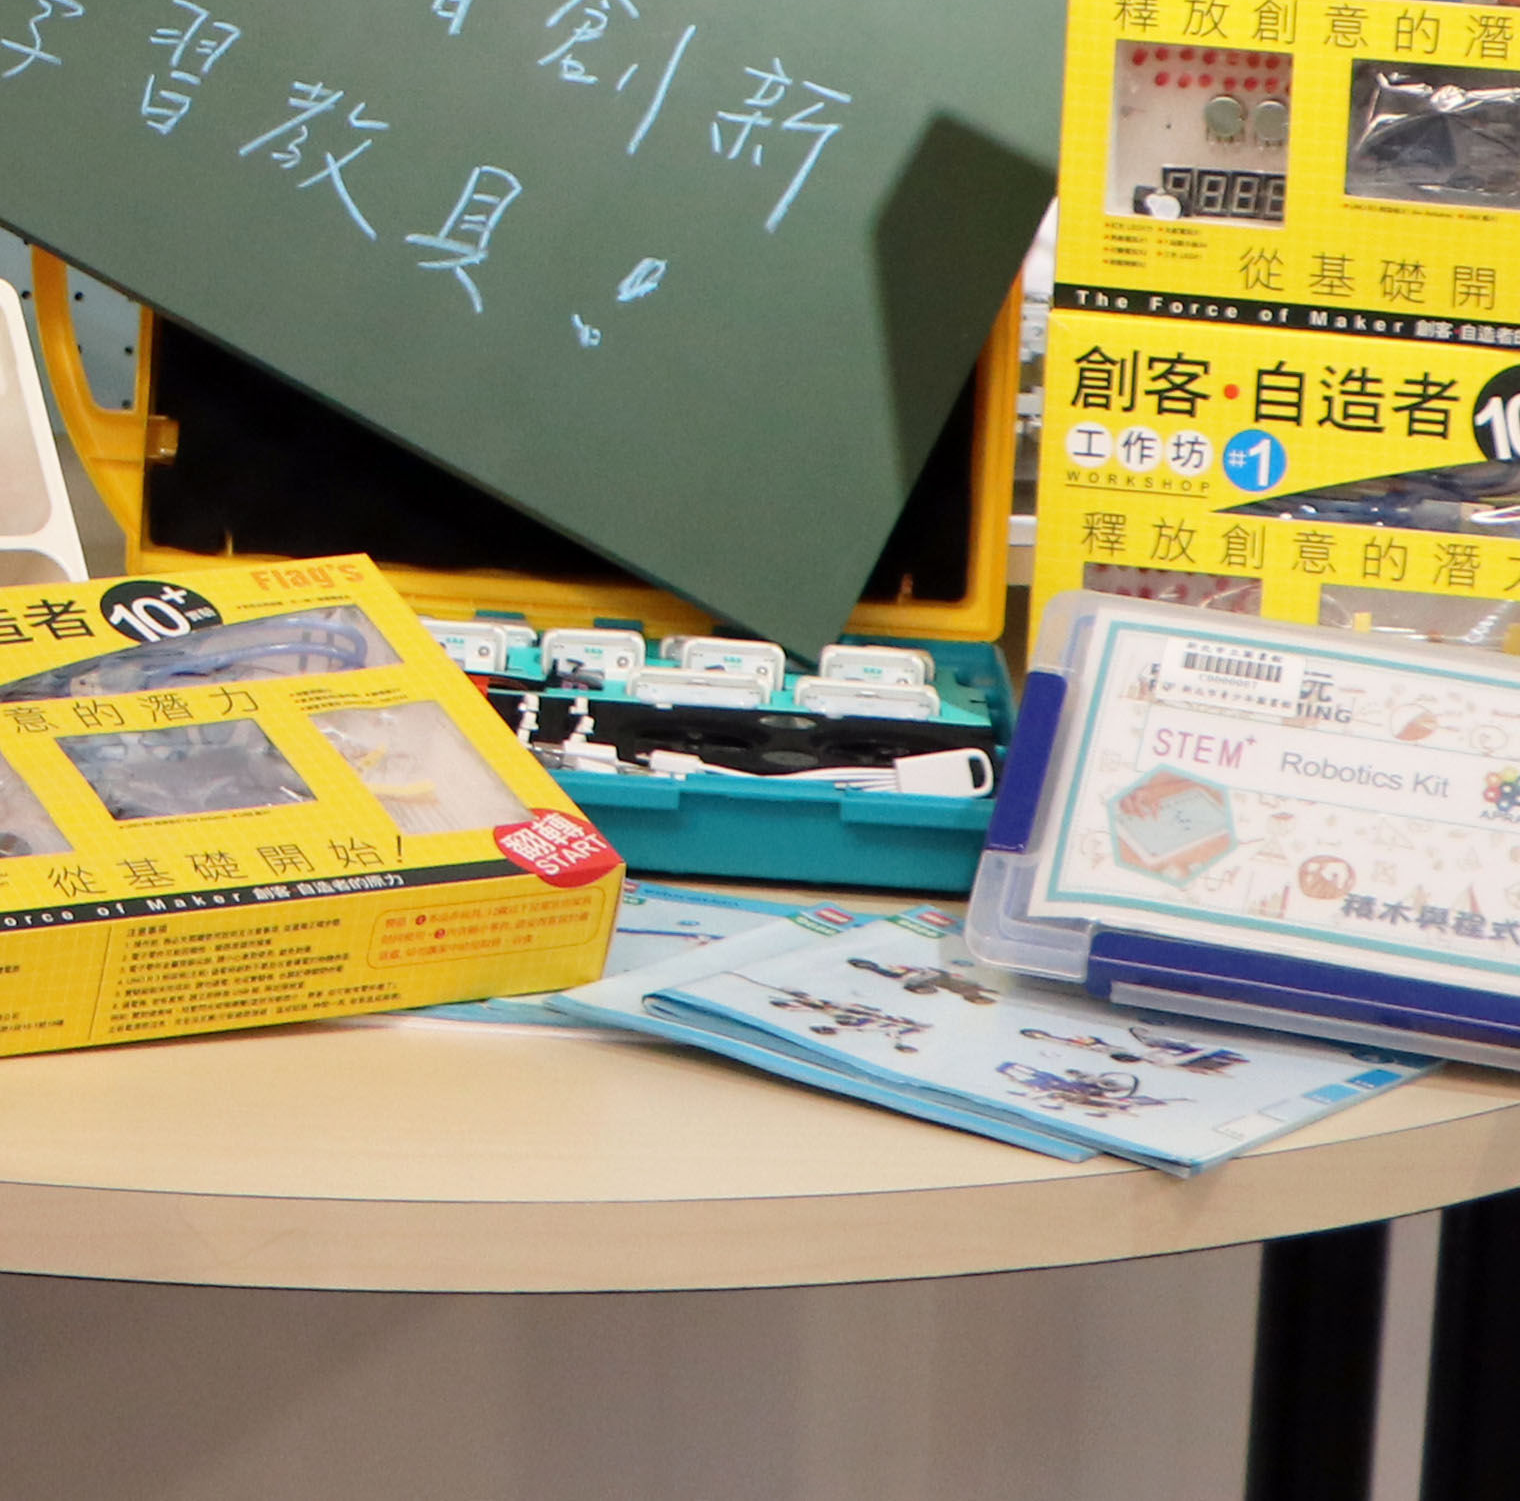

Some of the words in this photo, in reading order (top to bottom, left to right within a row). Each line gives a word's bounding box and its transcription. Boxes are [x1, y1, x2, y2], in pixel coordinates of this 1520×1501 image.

[1238, 246, 1498, 313] 從基礎開
[1076, 289, 1129, 310] The
[1149, 297, 1240, 320] Force
[1260, 307, 1290, 324] of
[1308, 309, 1405, 334] Maker
[1075, 424, 1210, 470] 工作坊
[1227, 437, 1273, 487] #1
[1066, 470, 1212, 494] WORKSHOP
[249, 561, 366, 592] Flag's
[1280, 750, 1404, 792] Robotics
[1412, 771, 1450, 799] Kit
[535, 831, 609, 877] START
[96, 902, 125, 917] of
[146, 890, 242, 912] Maker
